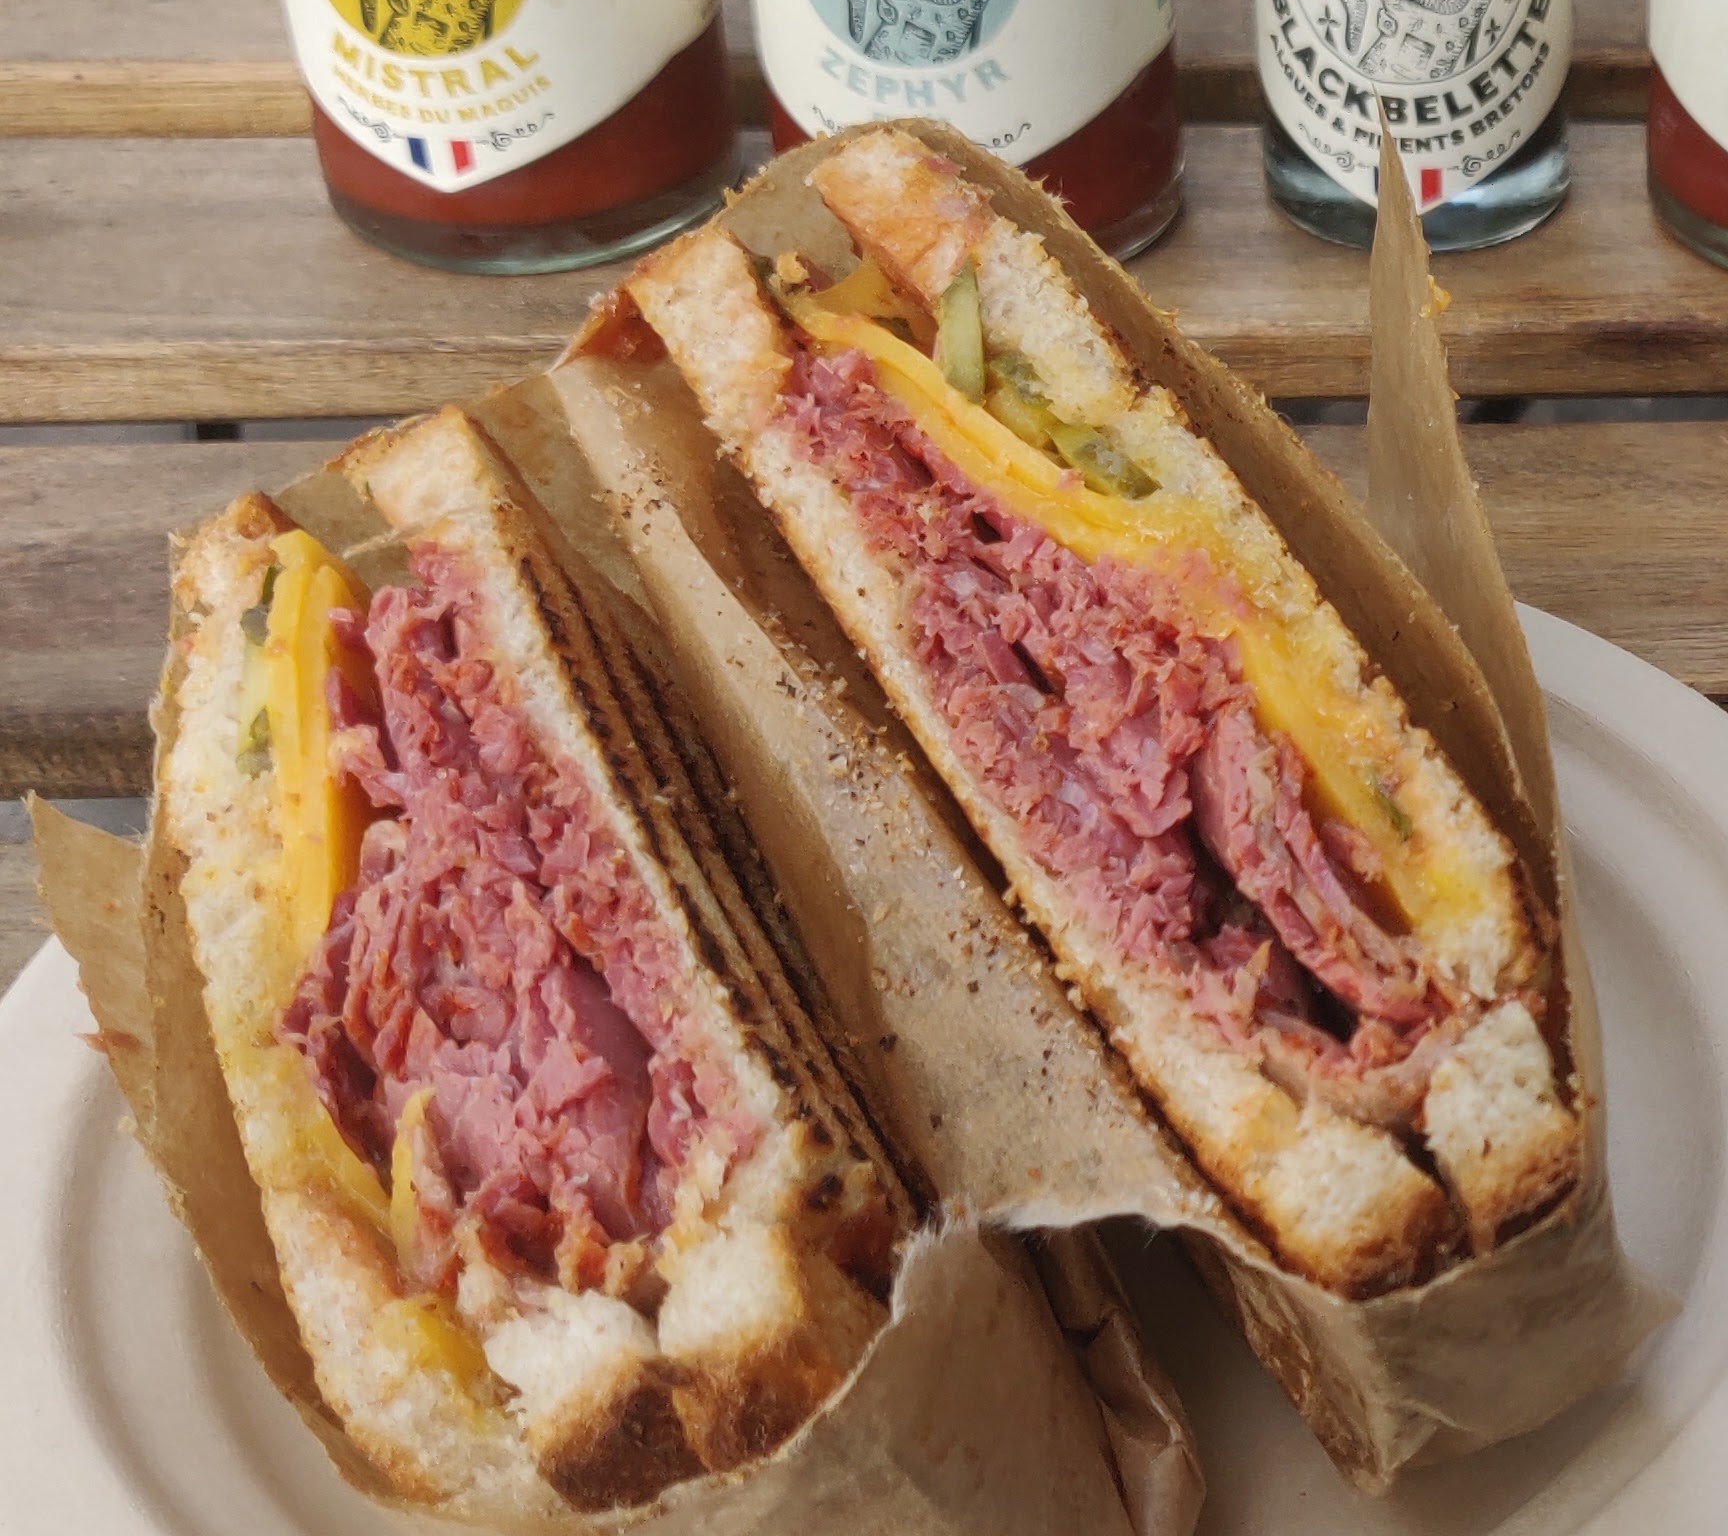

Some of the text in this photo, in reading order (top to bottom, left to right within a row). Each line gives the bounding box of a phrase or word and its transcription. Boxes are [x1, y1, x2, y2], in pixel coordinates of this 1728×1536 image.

[331, 31, 541, 99] MISTRAL
[820, 44, 1011, 108] ZEPHYR
[1469, 39, 1551, 137] BRETONS
